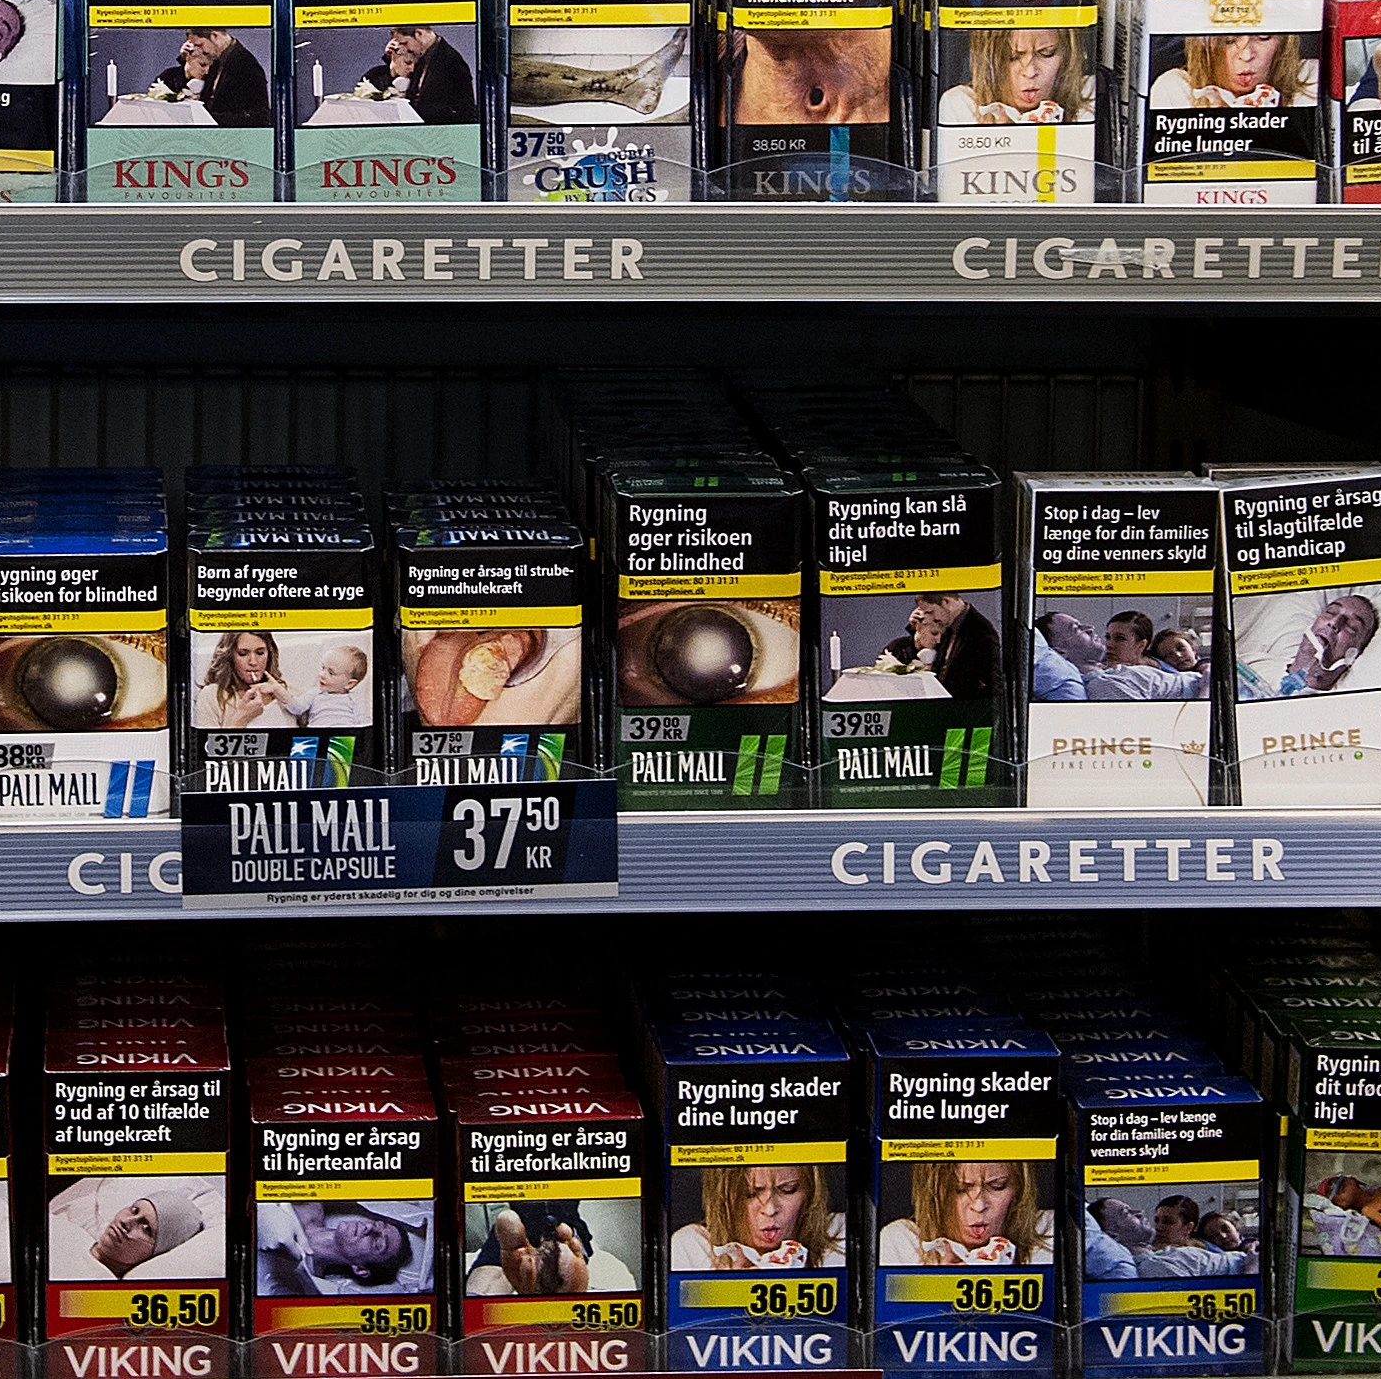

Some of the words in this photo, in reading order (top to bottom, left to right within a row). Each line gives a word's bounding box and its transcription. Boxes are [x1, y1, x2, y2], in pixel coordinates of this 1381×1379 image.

[511, 133, 544, 157] 37
[546, 133, 565, 145] 50
[959, 137, 991, 149] 38,50
[995, 137, 1011, 147] KR
[534, 162, 657, 192] CRUSH
[180, 239, 643, 281] CIGARETTER
[198, 566, 230, 579] Børn
[234, 565, 249, 578] af
[252, 568, 297, 582] rygere
[198, 584, 265, 601] begynder
[268, 583, 311, 597] oftere
[315, 585, 329, 597] at
[333, 586, 364, 600] ryge
[1051, 738, 1157, 756] PRINCE
[229, 802, 304, 855] PALL
[311, 799, 395, 852] MALL
[525, 797, 559, 831] 50
[452, 799, 520, 870] 37
[232, 859, 306, 882] DOUBLE
[311, 856, 395, 880] CAPSULE
[526, 846, 552, 869] KR
[832, 839, 1284, 884] CIGARETTER
[130, 1294, 217, 1327] 36,50
[64, 1346, 210, 1377] VIKING
